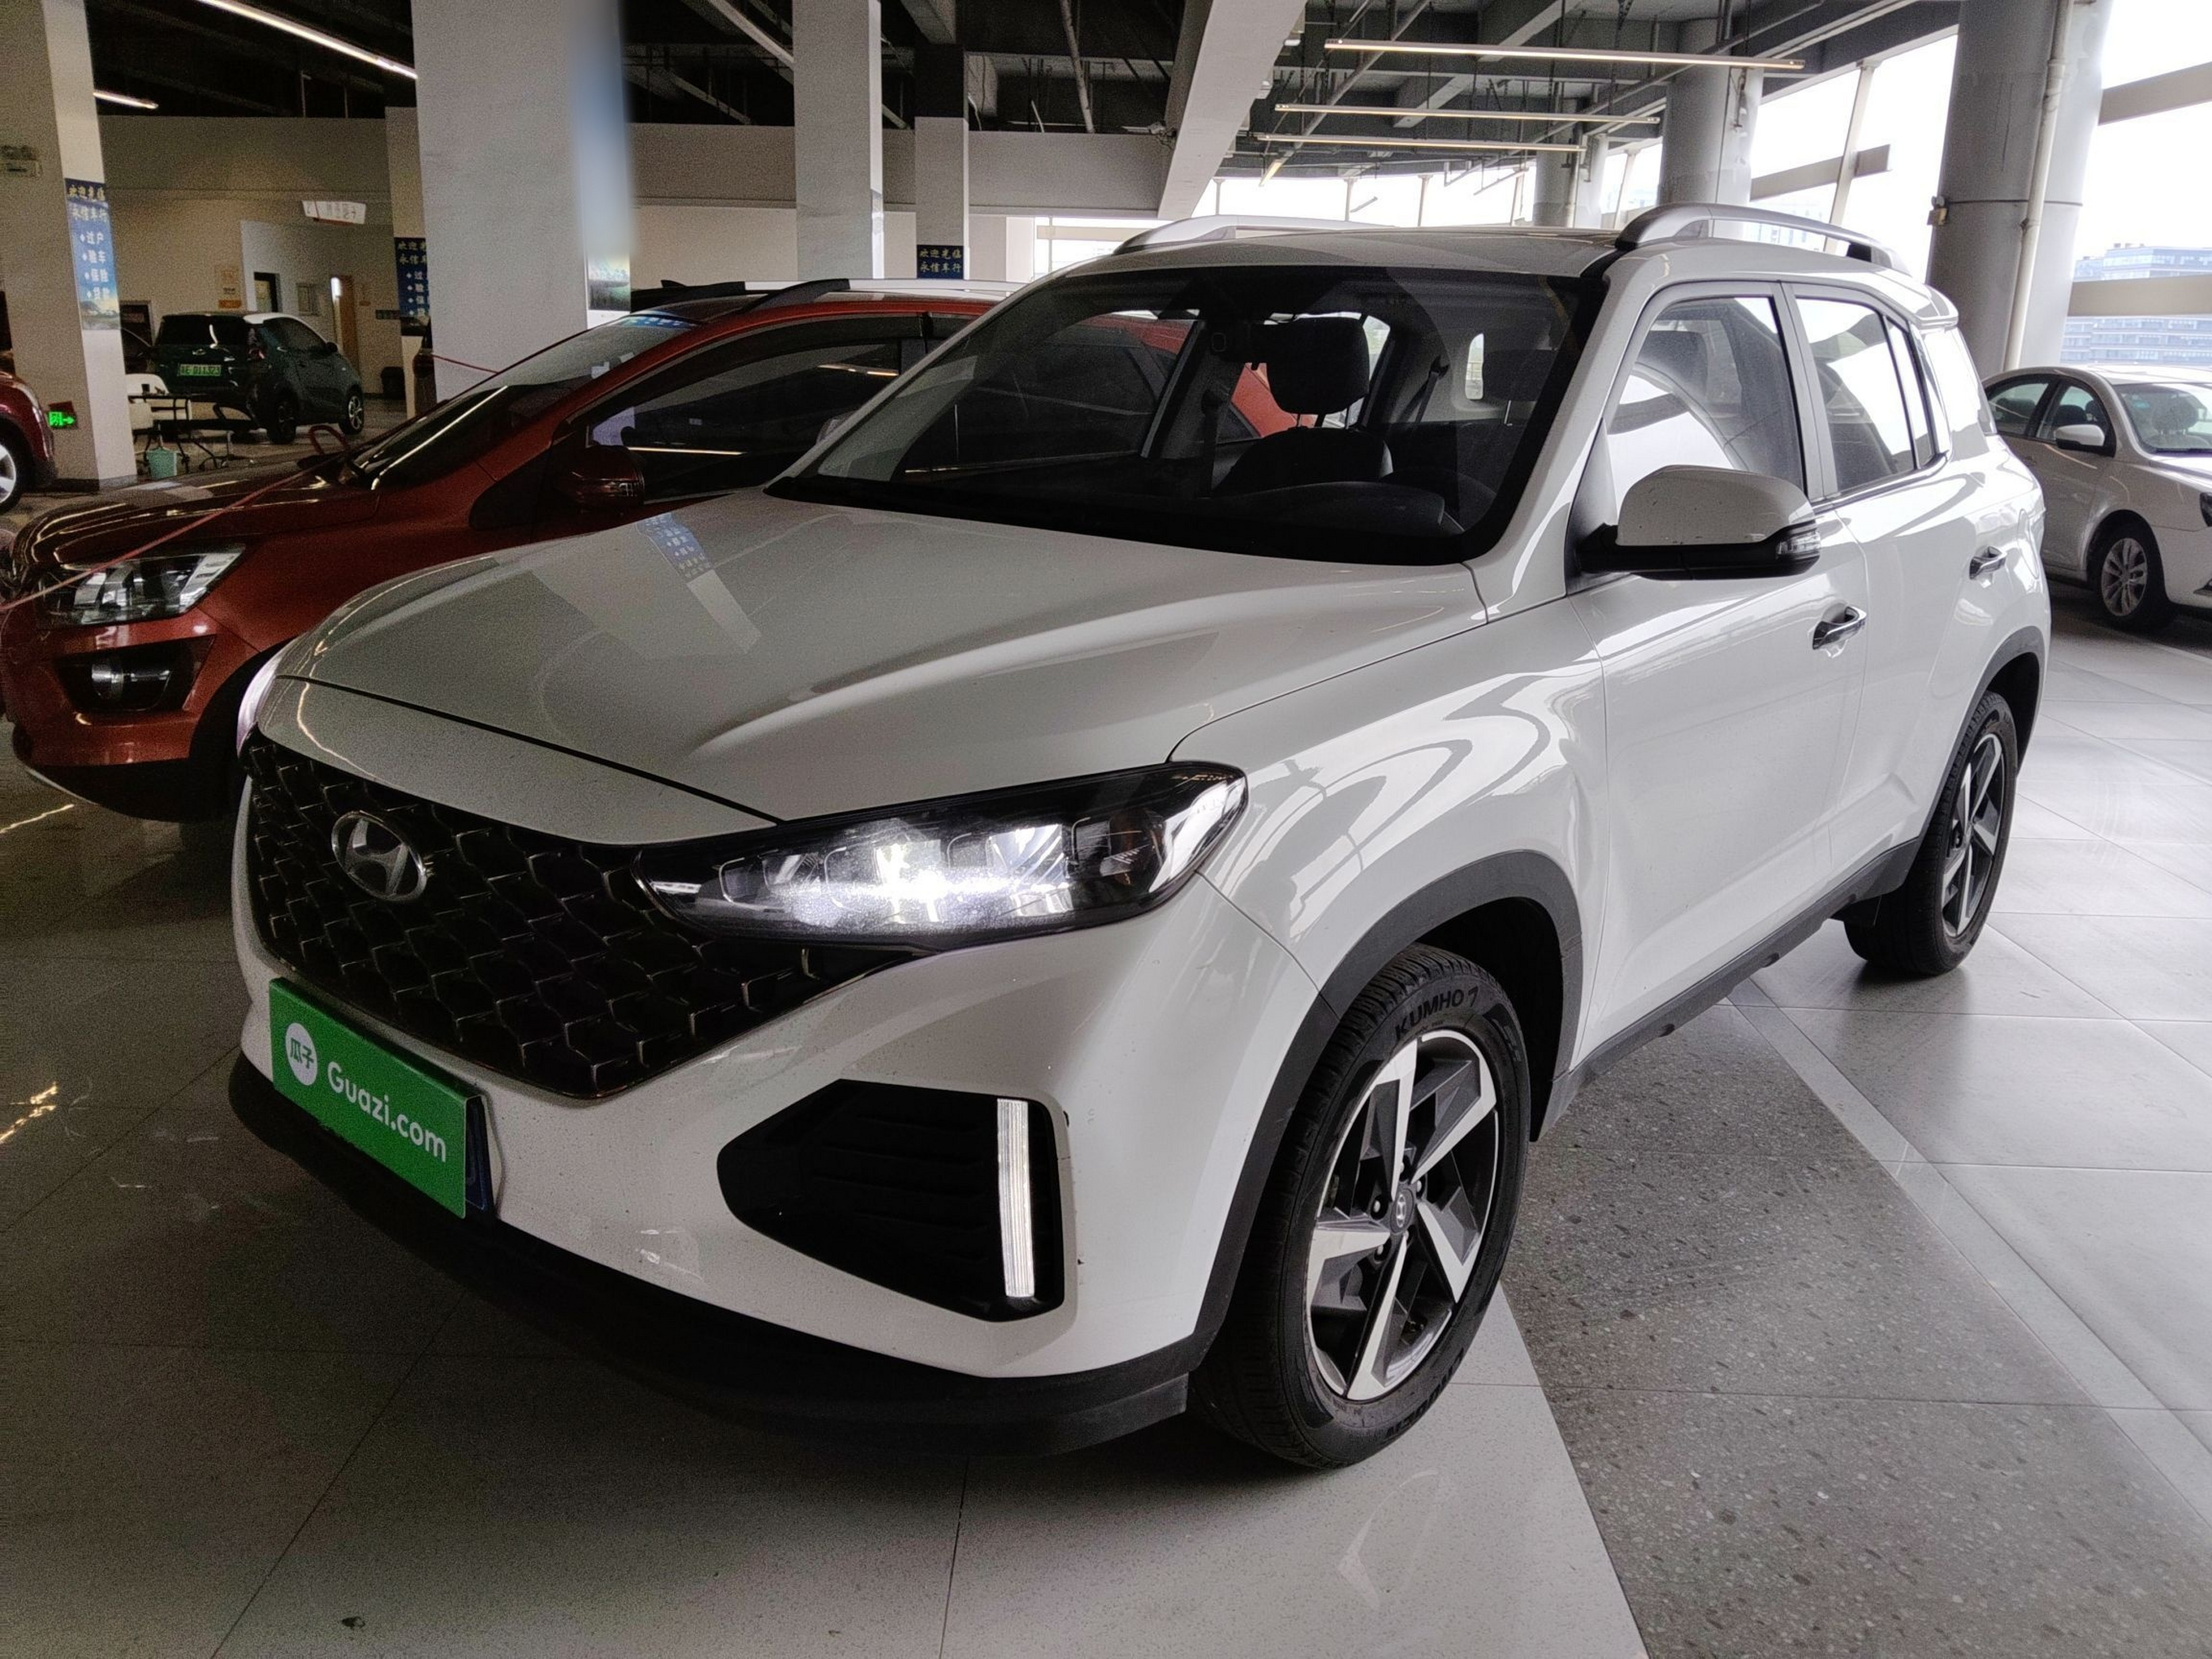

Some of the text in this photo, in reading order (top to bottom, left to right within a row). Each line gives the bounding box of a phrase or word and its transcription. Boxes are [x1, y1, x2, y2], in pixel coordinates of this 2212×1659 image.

[69, 184, 106, 202] 欢迎光临
[920, 248, 962, 260] 欢迎光临
[920, 261, 962, 273] 永信车行
[1395, 988, 1465, 1039] KUMHO
[290, 1037, 315, 1069] 瓜子
[328, 1061, 446, 1163] Guazi.com
